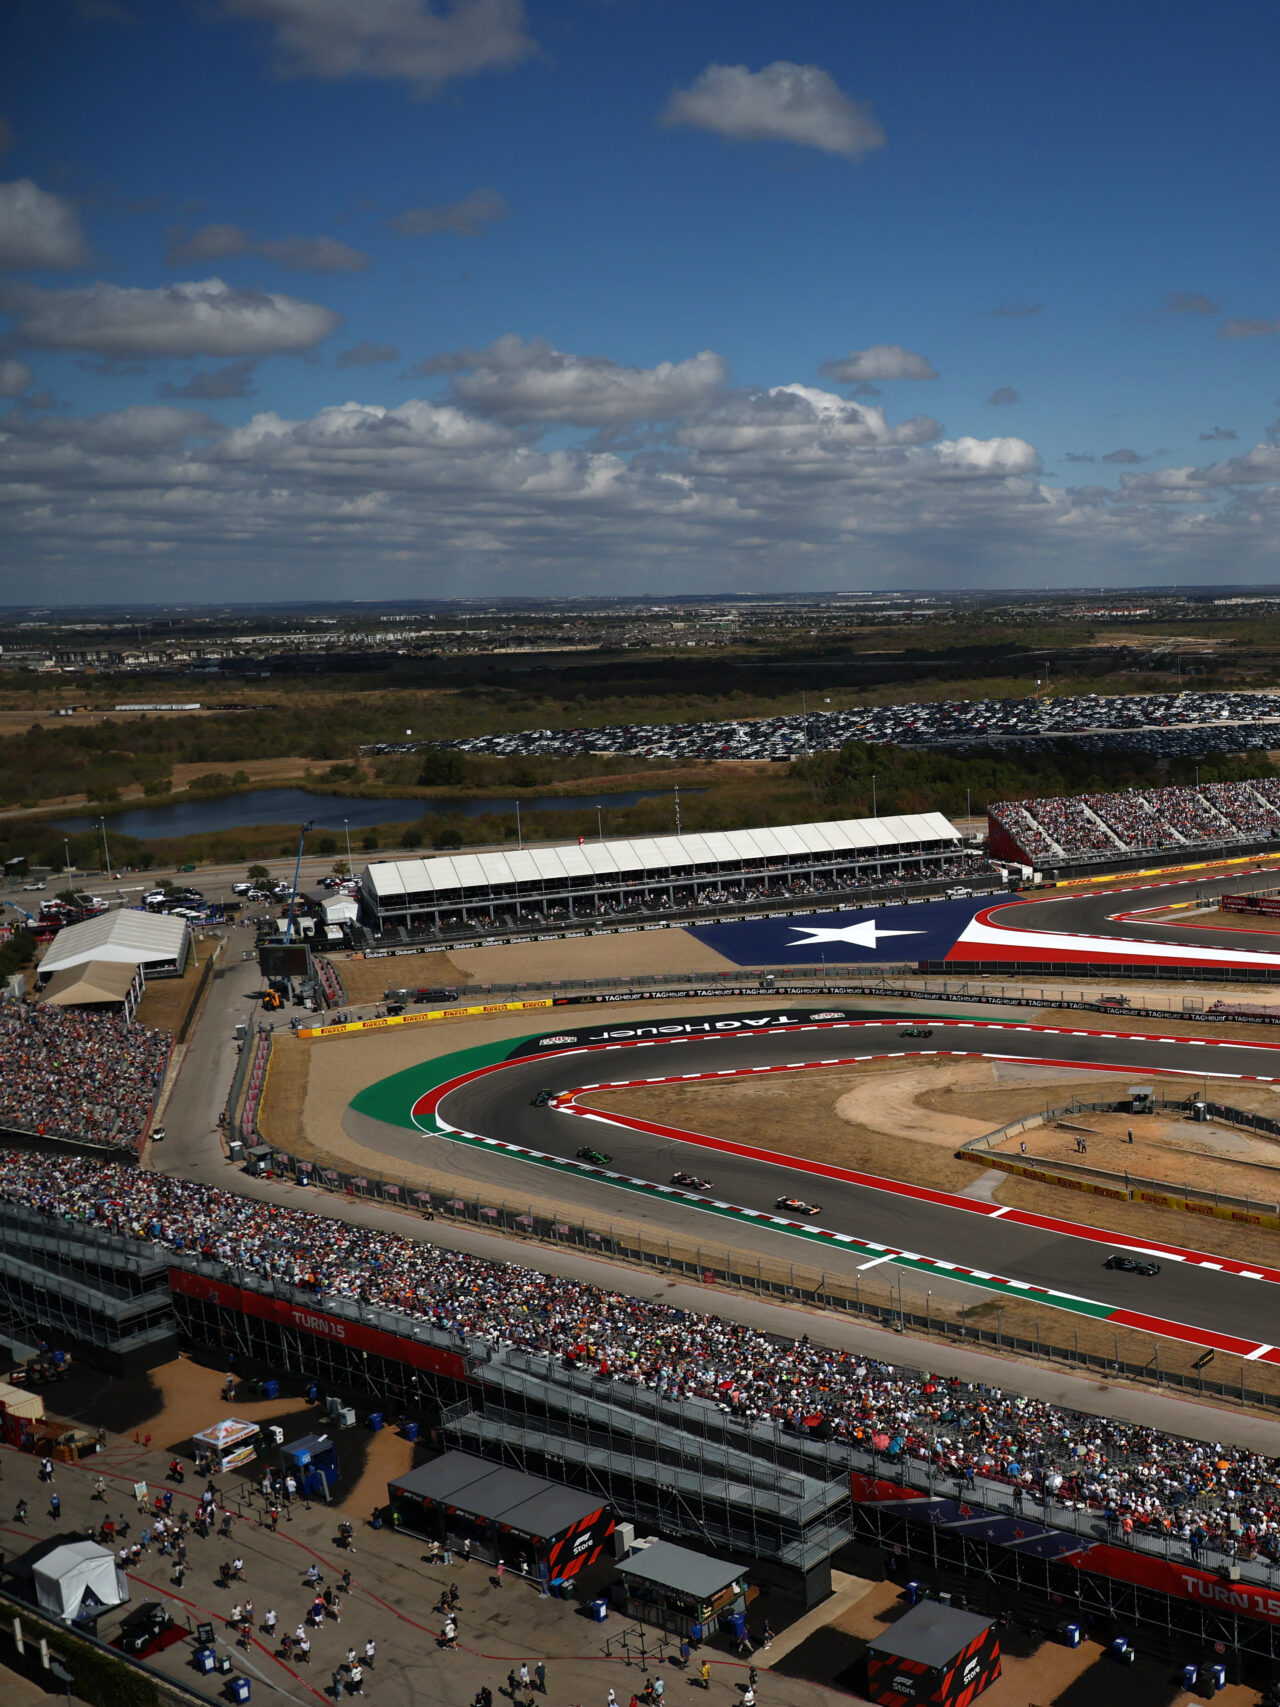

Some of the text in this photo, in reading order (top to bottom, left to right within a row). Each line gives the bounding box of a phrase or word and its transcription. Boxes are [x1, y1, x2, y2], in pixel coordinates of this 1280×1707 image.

[1141, 1193, 1168, 1206] PIRELLI
[1185, 1203, 1213, 1215] PIRELLI
[1232, 1212, 1260, 1225] PIRELLI
[292, 1311, 345, 1338] TURN 15
[573, 1538, 594, 1555] Store
[1181, 1574, 1249, 1608] TURN
[963, 1665, 981, 1685] Store
[892, 1682, 916, 1696] Store
